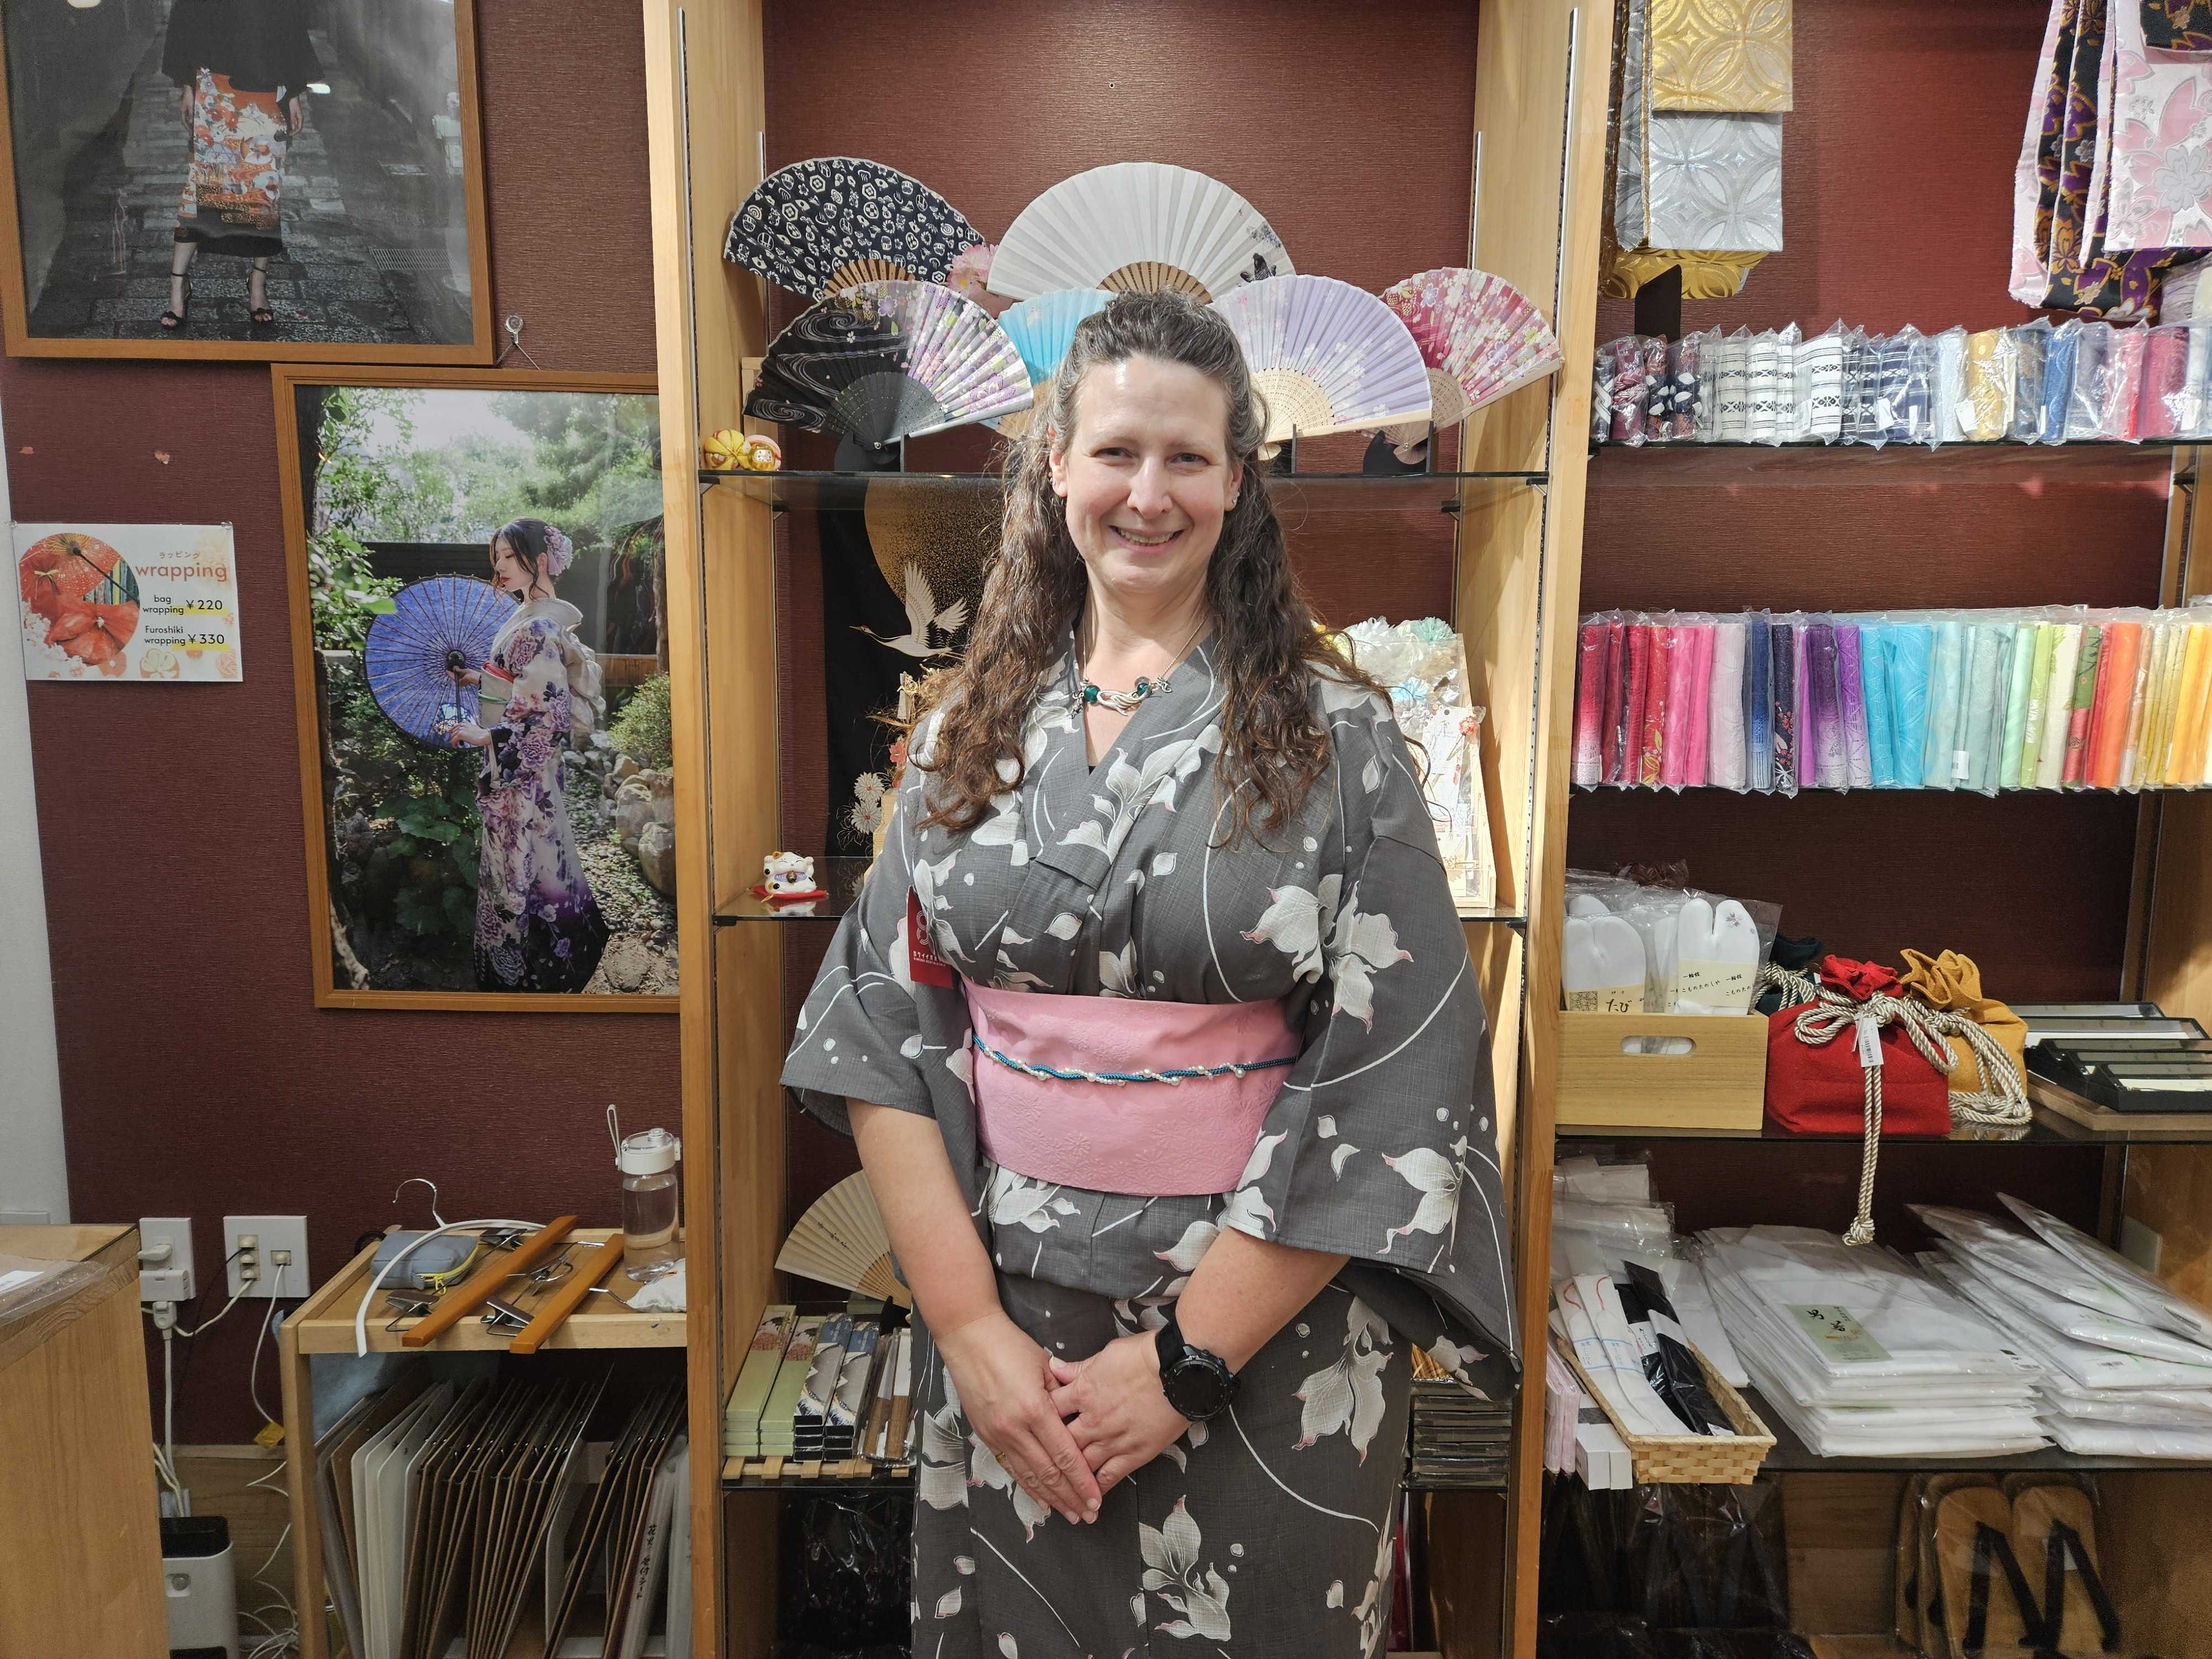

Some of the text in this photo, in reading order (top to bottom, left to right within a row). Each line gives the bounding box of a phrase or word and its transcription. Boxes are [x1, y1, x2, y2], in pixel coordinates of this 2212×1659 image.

[159, 550, 201, 559] ラッピング
[135, 562, 227, 582] wrapping
[154, 594, 171, 604] bag
[142, 606, 184, 615] wrapping
[145, 625, 184, 634] Furoshiki
[144, 637, 186, 646] wrapping
[1605, 998, 1632, 1013] たび
